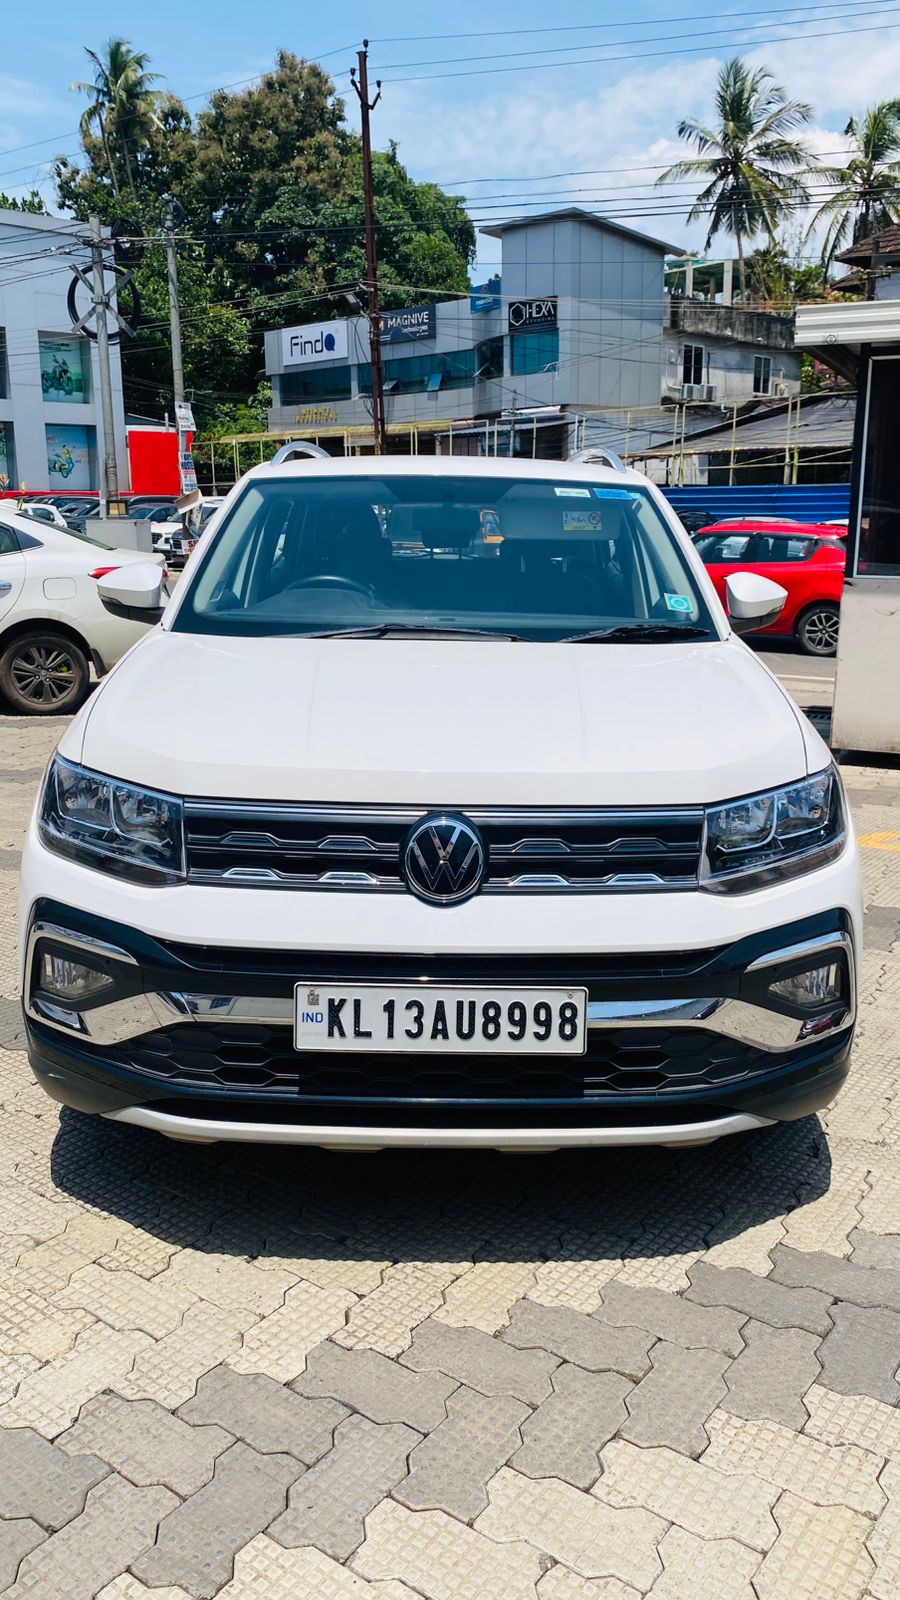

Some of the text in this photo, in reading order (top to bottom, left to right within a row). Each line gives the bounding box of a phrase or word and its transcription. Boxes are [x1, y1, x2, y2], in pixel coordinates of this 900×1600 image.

[526, 301, 555, 318] HEXA
[387, 311, 429, 328] MAGNIVE
[290, 330, 336, 357] FindQ
[302, 1012, 324, 1023] IND
[327, 997, 579, 1042] KL13AU8998
